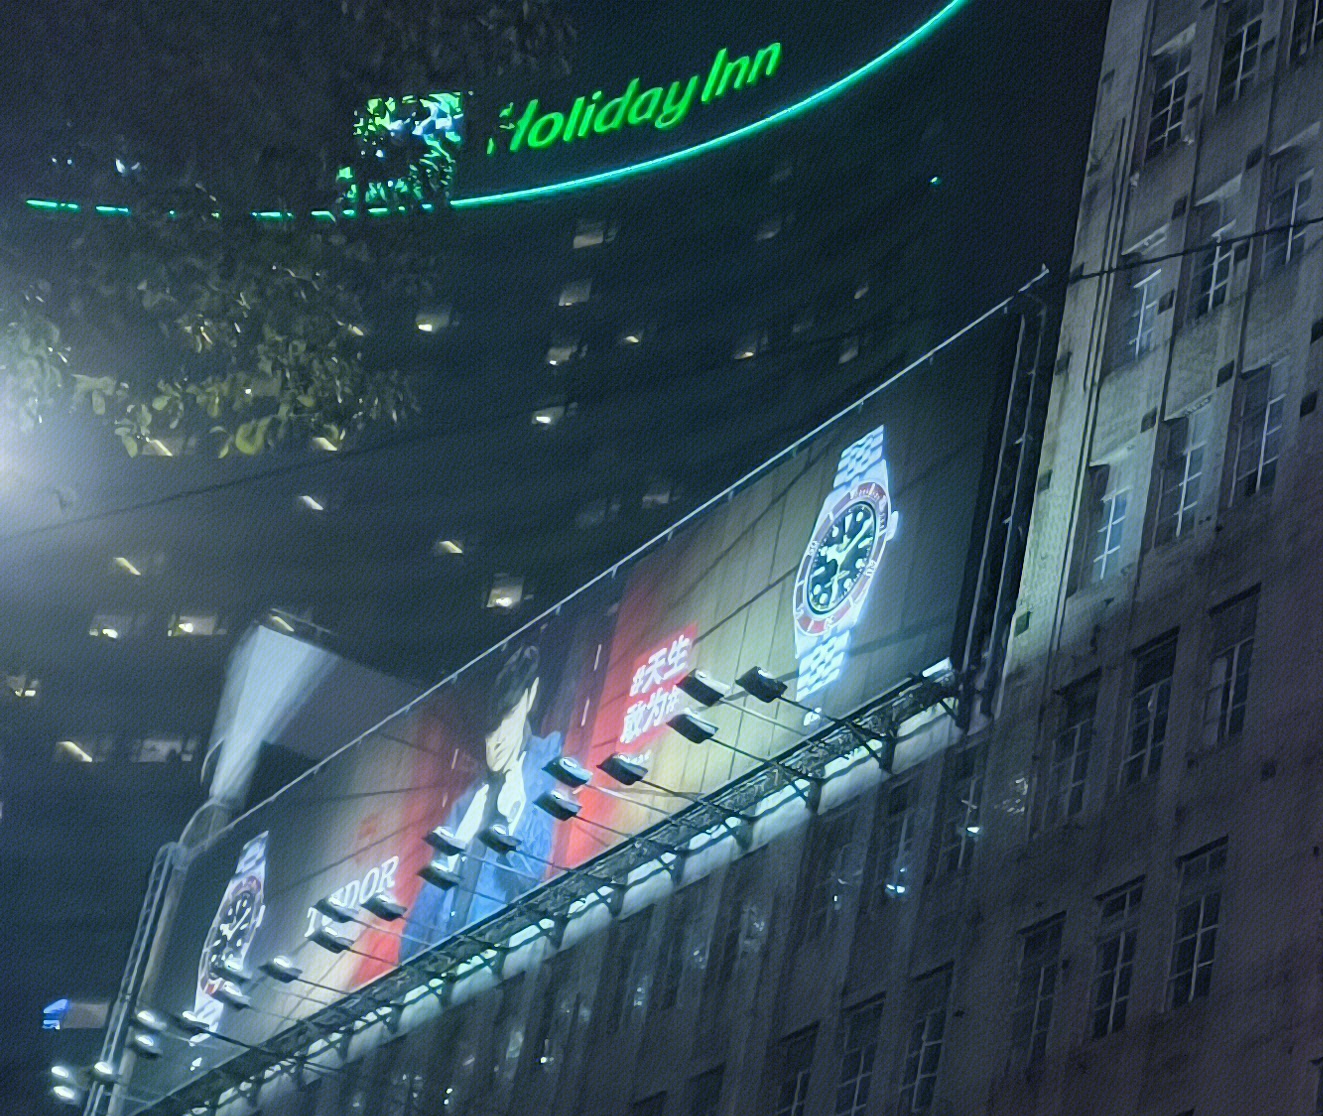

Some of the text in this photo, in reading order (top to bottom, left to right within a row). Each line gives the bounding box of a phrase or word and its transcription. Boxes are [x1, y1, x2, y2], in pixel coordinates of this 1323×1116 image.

[701, 43, 781, 102] Inn
[629, 634, 691, 697] #天生
[303, 855, 400, 938] TDOR
